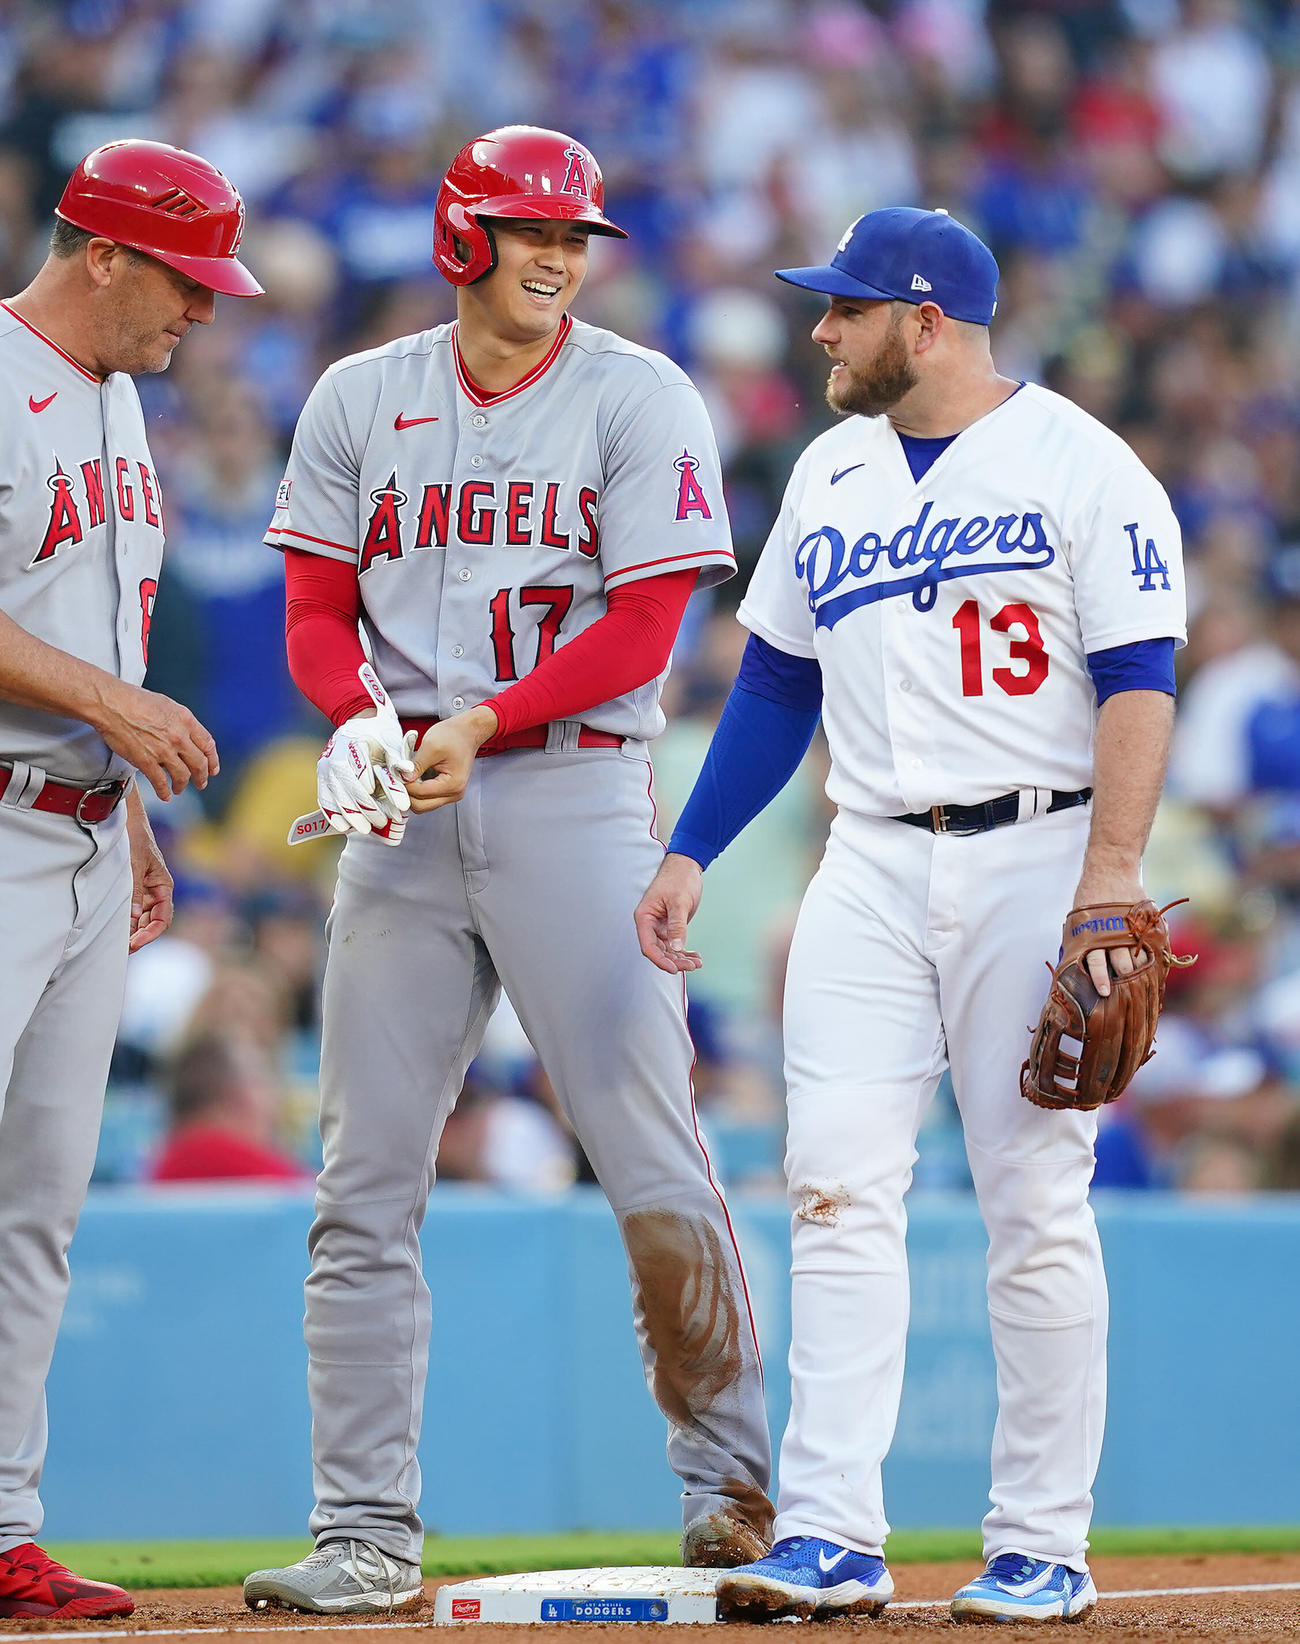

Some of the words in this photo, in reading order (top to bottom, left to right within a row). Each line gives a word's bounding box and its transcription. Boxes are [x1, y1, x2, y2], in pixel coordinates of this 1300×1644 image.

[358, 463, 599, 580] ANGELS
[671, 444, 715, 523] A
[795, 501, 1054, 632] Dodgers
[1123, 522, 1172, 592] LA
[489, 584, 575, 683] 17
[952, 599, 1050, 697] 13
[296, 819, 327, 835] SO17
[1072, 916, 1125, 936] Wilson
[576, 1607, 632, 1616] DODGERS
